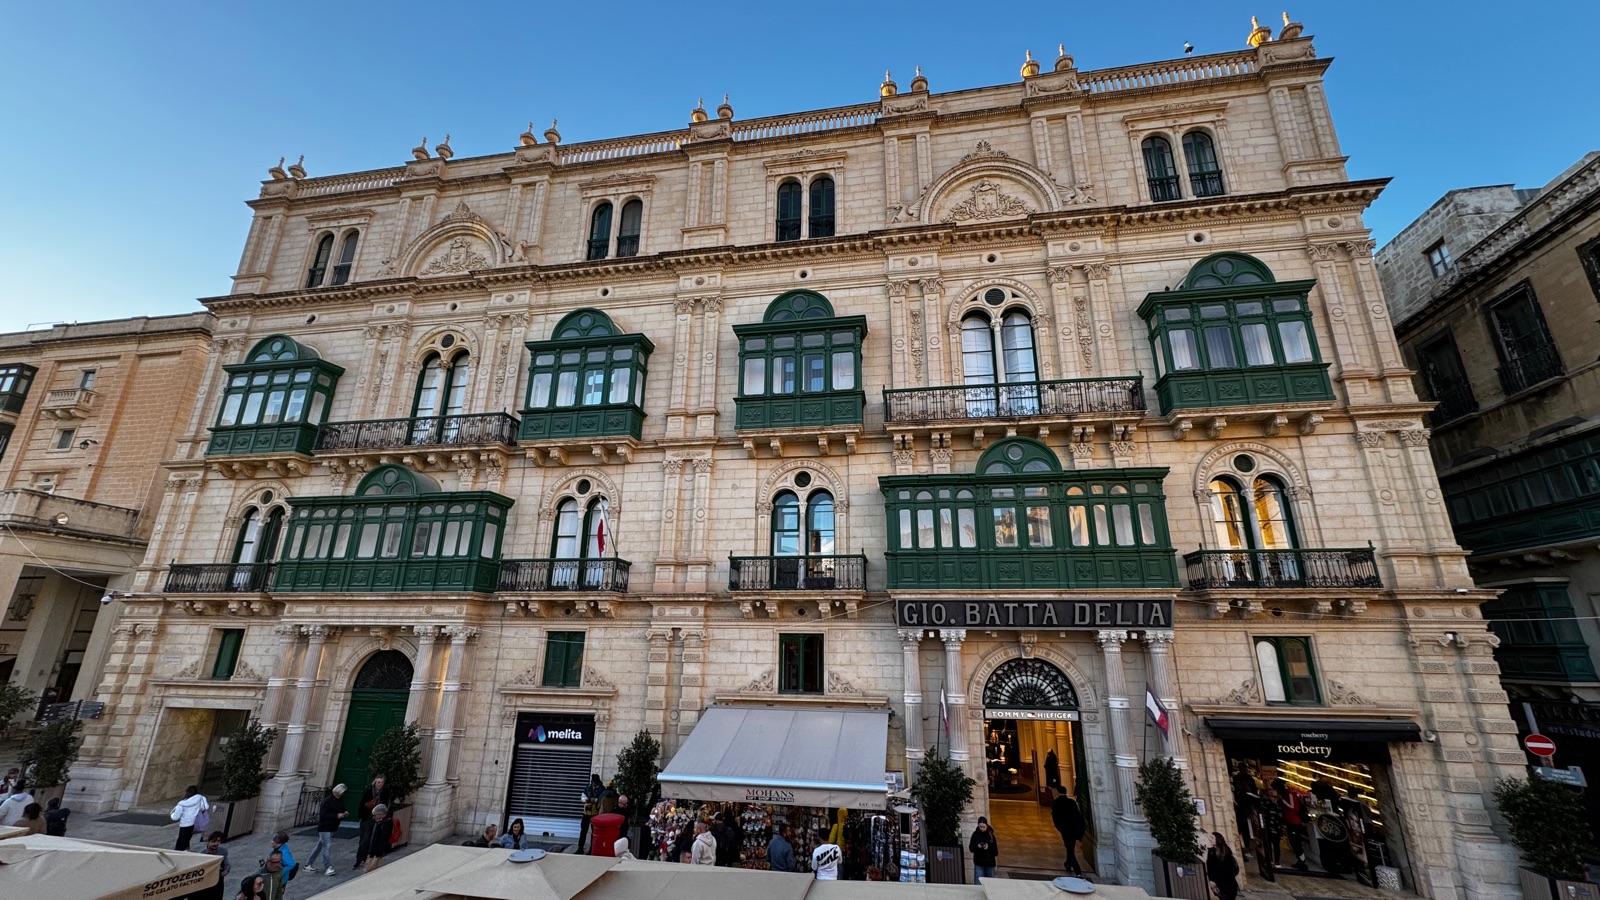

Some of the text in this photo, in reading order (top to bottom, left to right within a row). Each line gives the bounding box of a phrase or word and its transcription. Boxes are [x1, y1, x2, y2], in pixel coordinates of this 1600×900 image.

[903, 602, 1166, 625] GIO. BATTA DELIA
[547, 728, 582, 739] melita
[1301, 732, 1328, 740] roseberry
[1277, 741, 1332, 758] roseberry
[746, 789, 794, 798] MOHANS
[142, 876, 205, 899] THE GELATO FACTORY
[144, 868, 205, 892] SOTTOZERO
